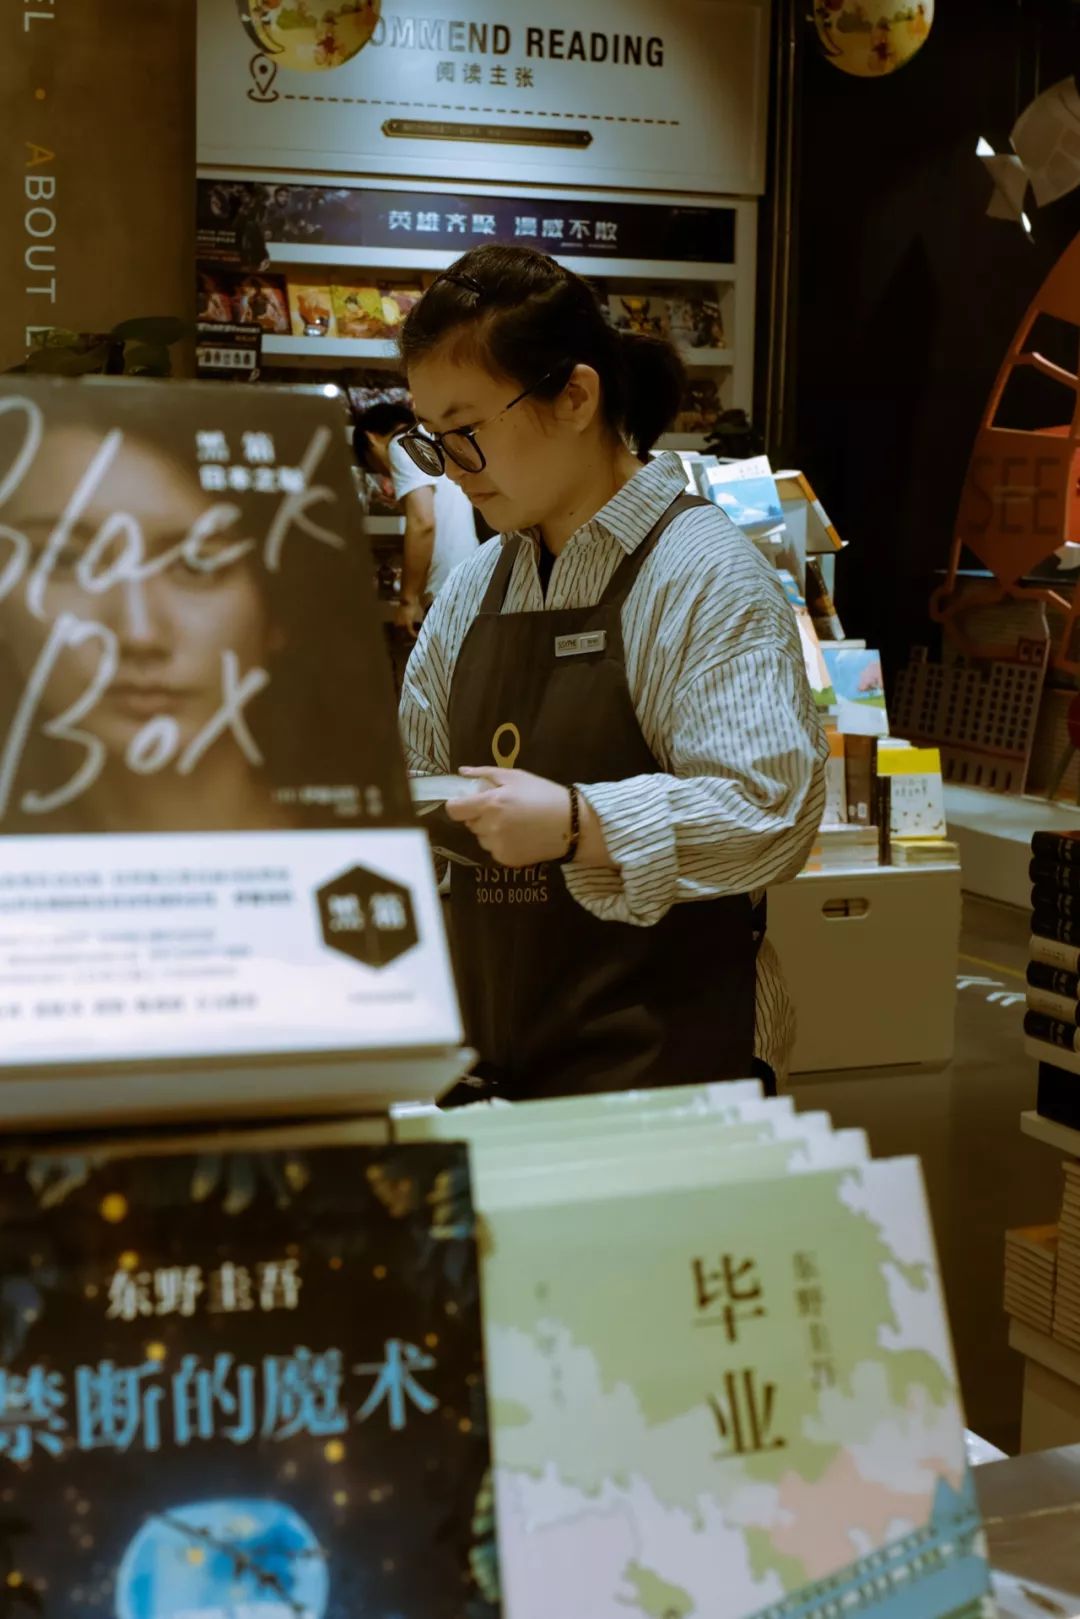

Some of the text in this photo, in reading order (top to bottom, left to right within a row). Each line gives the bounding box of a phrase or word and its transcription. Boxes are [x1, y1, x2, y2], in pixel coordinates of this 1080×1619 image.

[369, 16, 664, 68] OMMEND READING
[436, 61, 535, 88] 阅读主张
[25, 142, 56, 303] ABOUT
[967, 455, 1061, 536] SEE
[0, 612, 270, 820] Box
[476, 886, 548, 904] SOLO BOOKS
[105, 1258, 302, 1321] 东野圭吾
[690, 1252, 788, 1461] 毕业
[0, 1338, 438, 1461] 禁断的魔术
